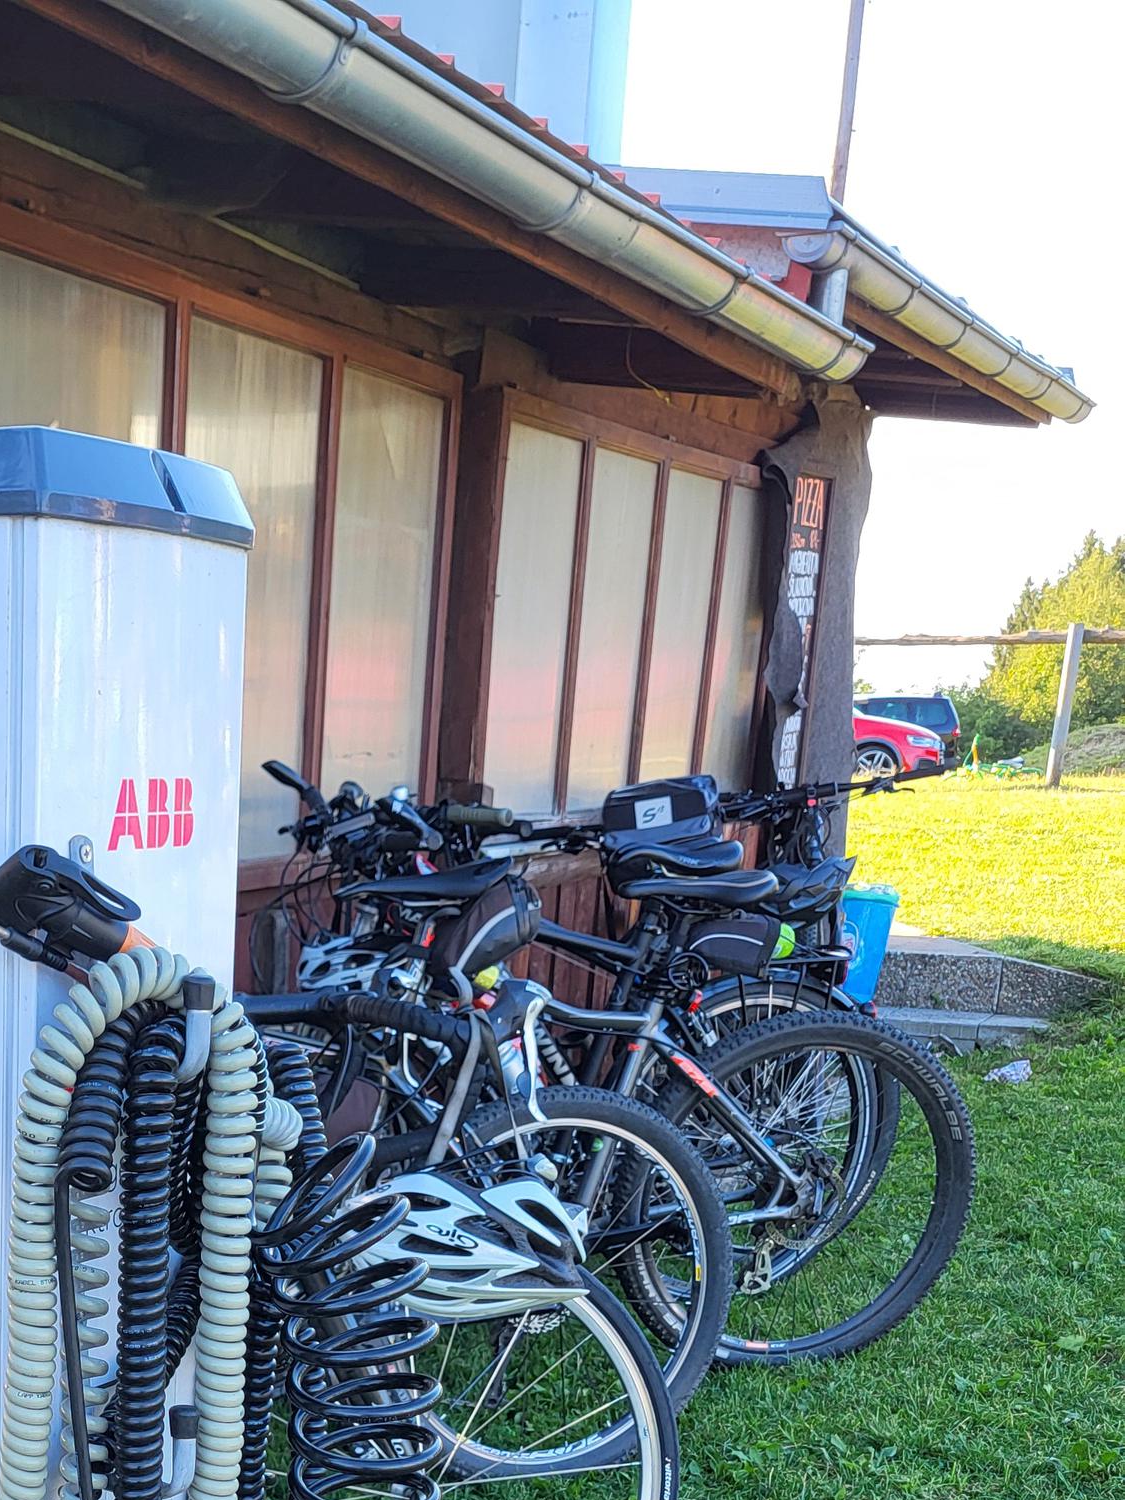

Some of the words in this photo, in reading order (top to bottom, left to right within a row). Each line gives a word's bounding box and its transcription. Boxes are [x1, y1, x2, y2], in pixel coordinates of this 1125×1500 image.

[793, 476, 825, 530] PIZZA
[107, 777, 195, 852] ABB
[425, 1223, 479, 1250] Giro
